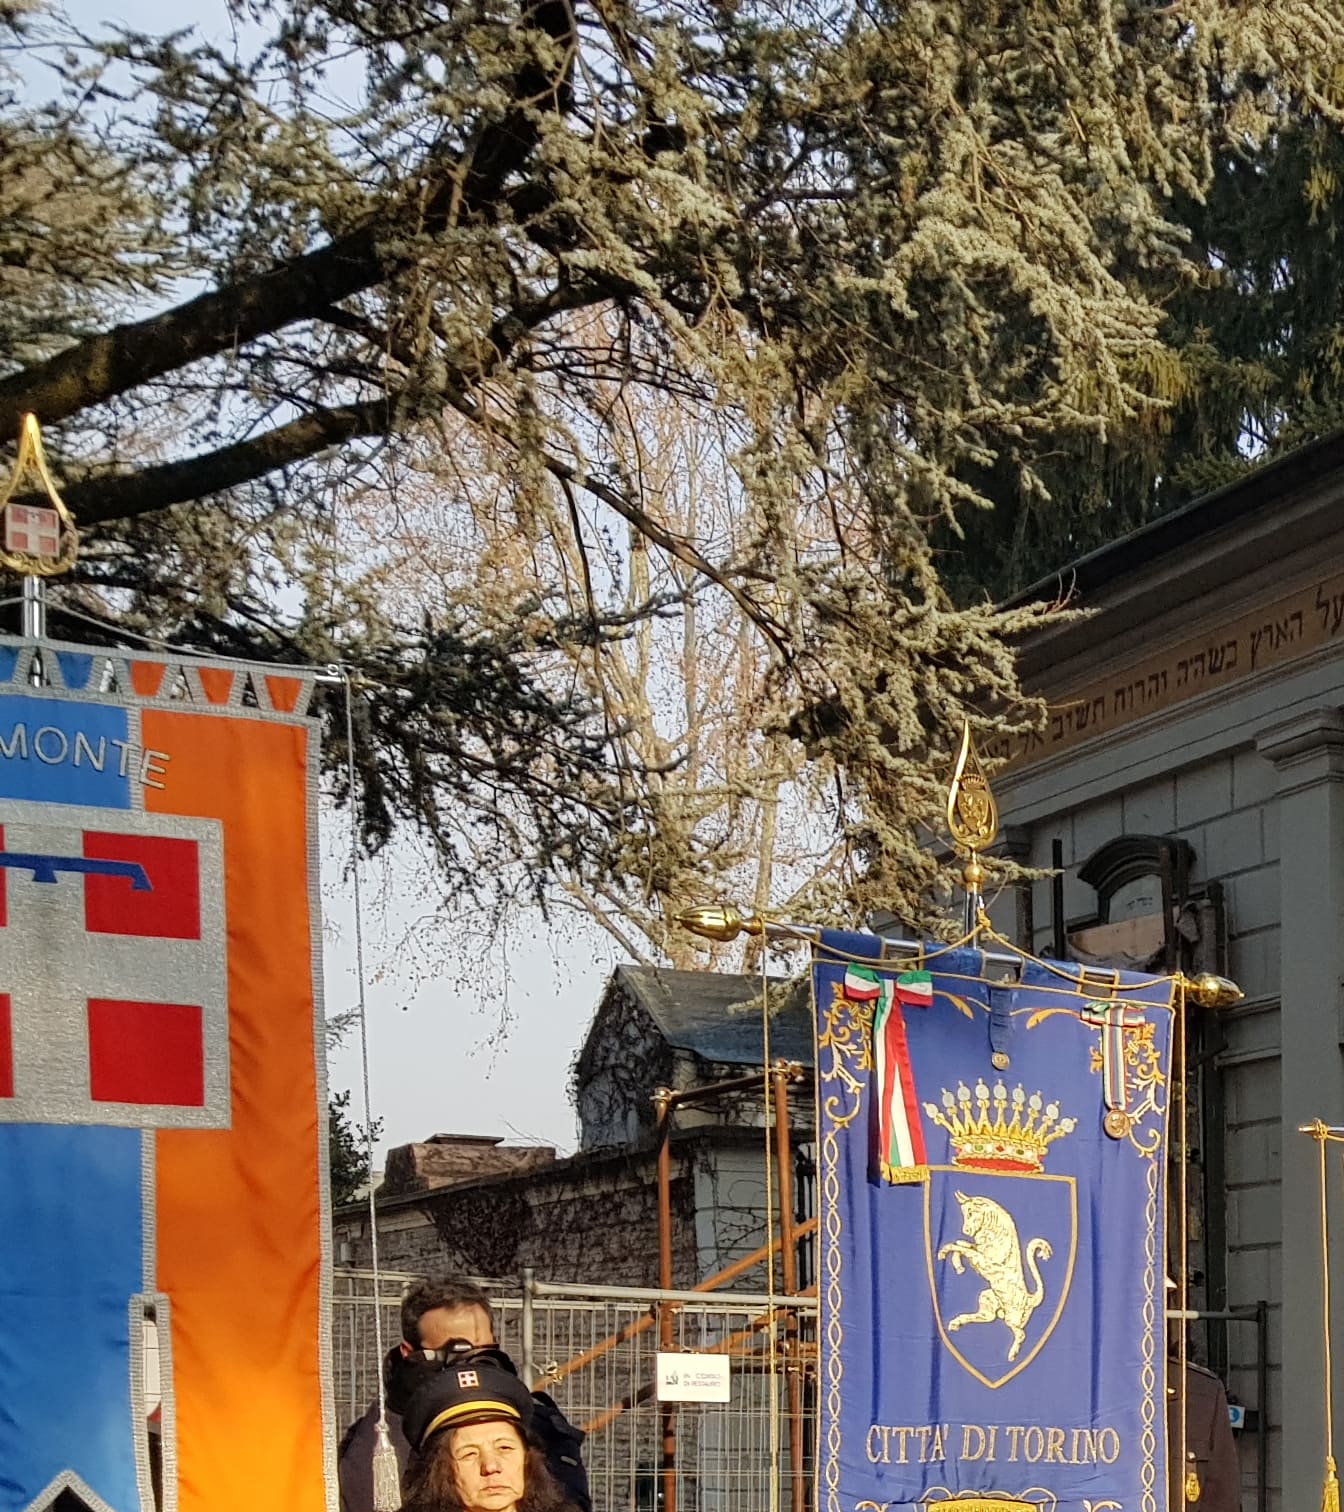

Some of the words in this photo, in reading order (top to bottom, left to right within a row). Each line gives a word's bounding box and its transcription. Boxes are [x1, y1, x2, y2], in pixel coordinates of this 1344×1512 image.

[866, 1423, 949, 1463] CITTA'
[960, 1424, 999, 1462] DI
[1006, 1426, 1121, 1465] TORINO
